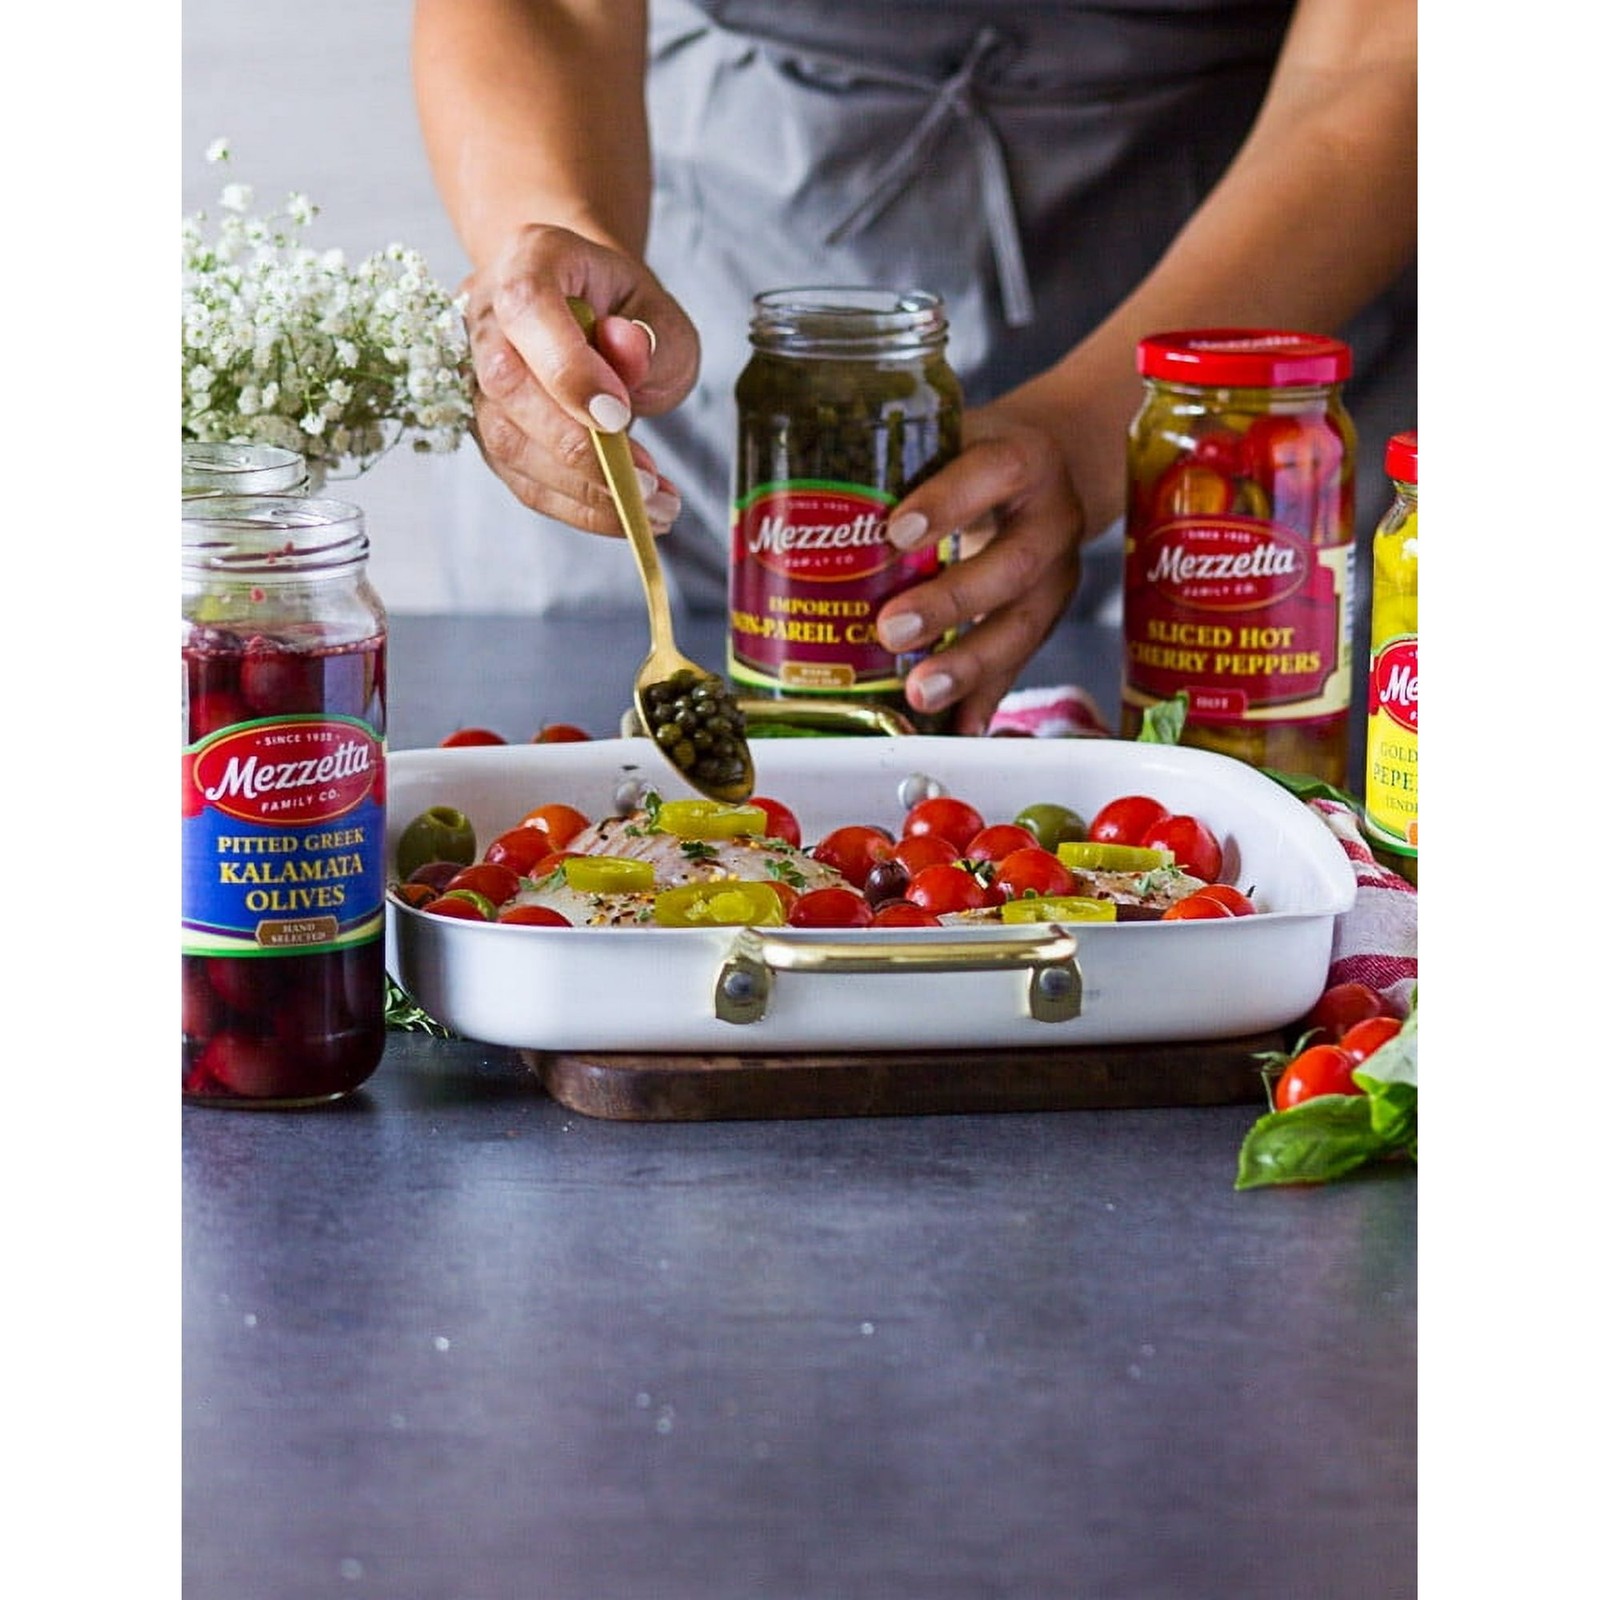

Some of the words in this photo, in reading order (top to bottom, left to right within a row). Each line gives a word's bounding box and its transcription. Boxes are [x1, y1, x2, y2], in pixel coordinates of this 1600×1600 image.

[1147, 543, 1295, 583] Mezzetta
[769, 597, 870, 616] IMPORTED
[1147, 619, 1233, 648] SLICED
[1239, 627, 1295, 649] HOT
[1213, 651, 1322, 676] PEPPERS
[264, 733, 301, 747] SINCE
[205, 740, 369, 800] Mezzetta
[261, 794, 313, 813] FAMILY
[217, 836, 298, 853] PITTED
[303, 826, 365, 852] GREEK
[218, 852, 365, 884] KALAMATA
[245, 883, 346, 912] OLIVES
